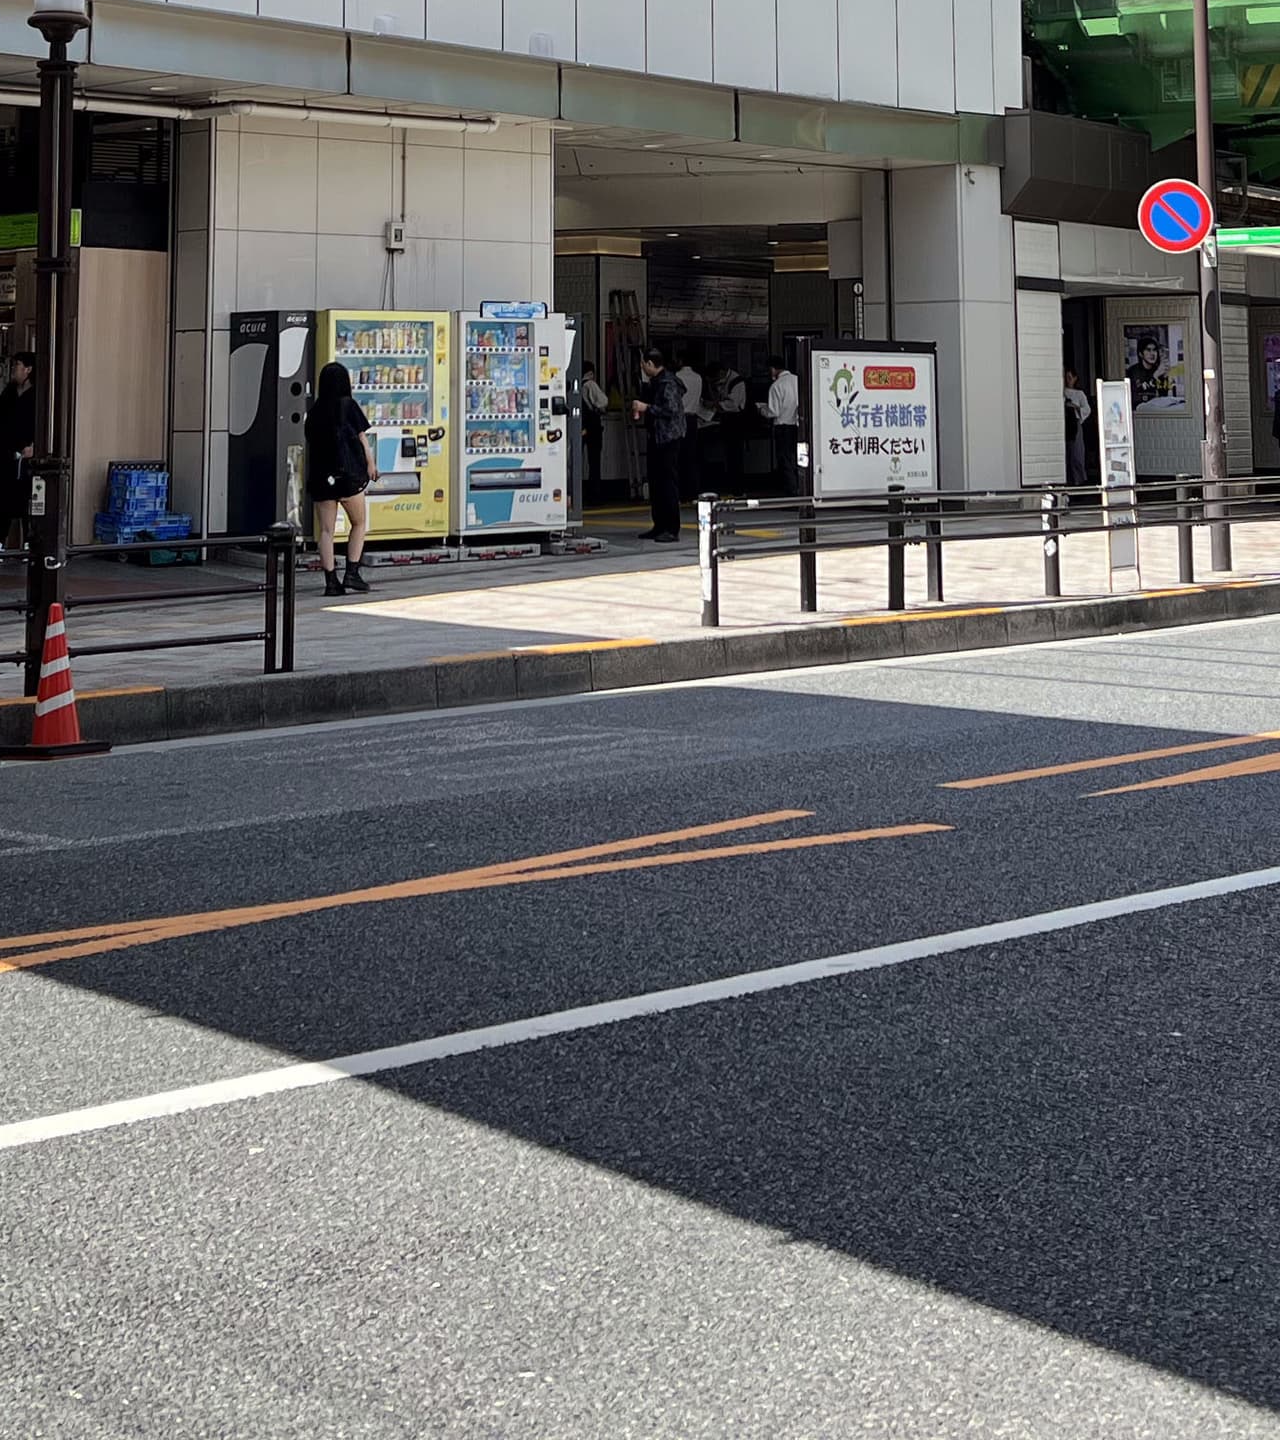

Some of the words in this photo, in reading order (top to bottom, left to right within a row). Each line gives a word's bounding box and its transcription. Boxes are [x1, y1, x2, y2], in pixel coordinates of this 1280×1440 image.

[239, 320, 267, 334] acure
[840, 403, 928, 428] 歩行者横断帯
[829, 436, 926, 456] をご利用ください
[519, 492, 550, 504] acure
[394, 501, 422, 512] acure
